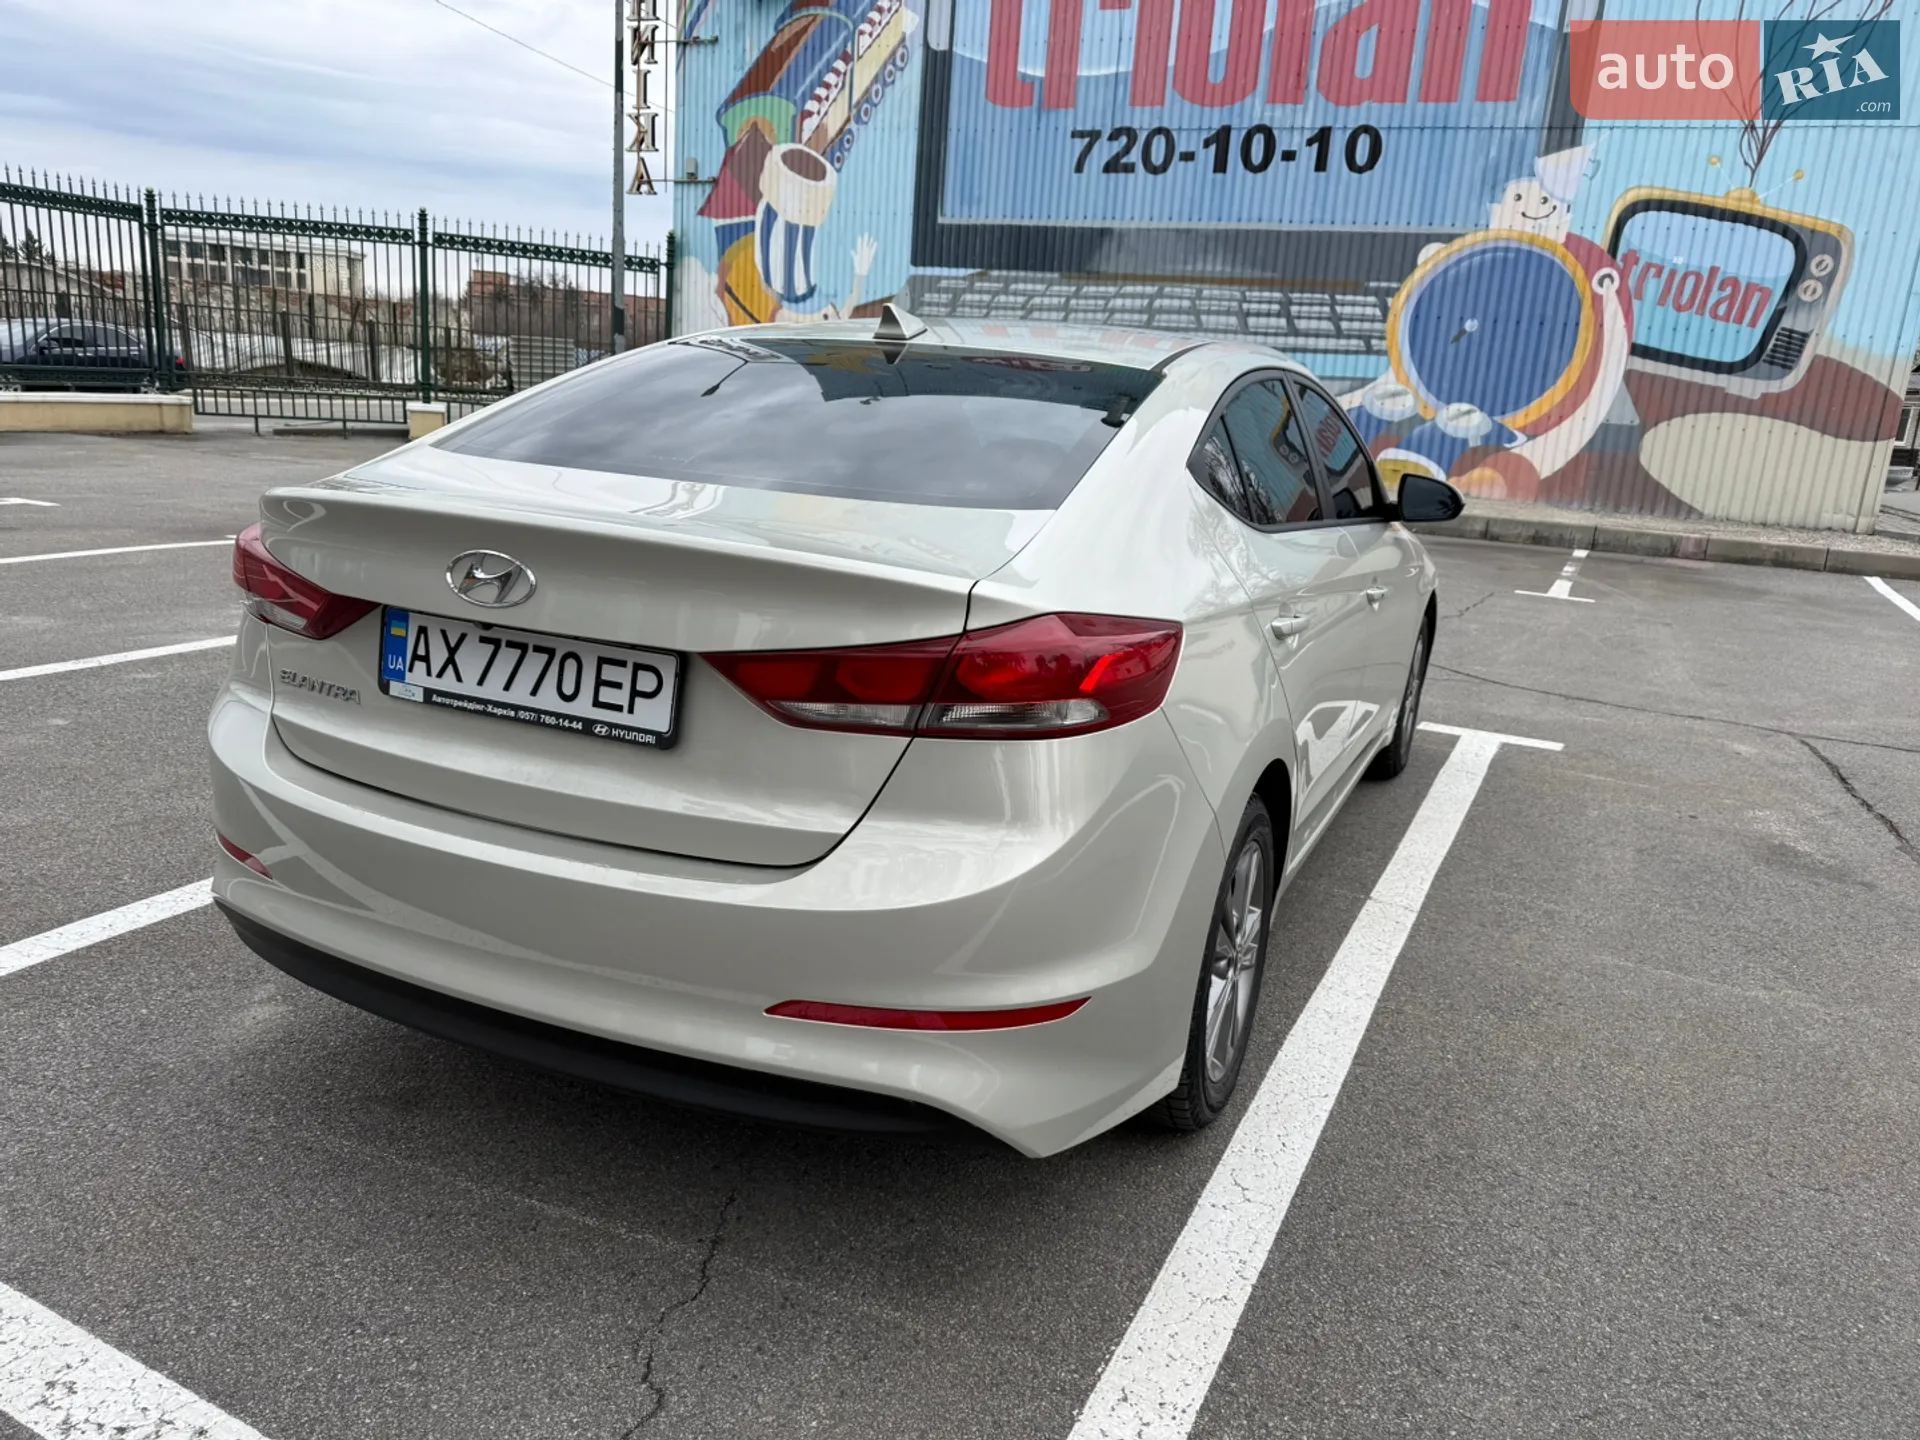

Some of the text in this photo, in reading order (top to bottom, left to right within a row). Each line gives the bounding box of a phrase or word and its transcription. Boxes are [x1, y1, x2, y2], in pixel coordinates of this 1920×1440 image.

[1070, 124, 1383, 175] 720-10-10
[1617, 248, 1774, 328] triolan
[388, 654, 404, 671] UA
[280, 668, 361, 704] ELANTRA
[611, 727, 656, 744] HYUNDAI
